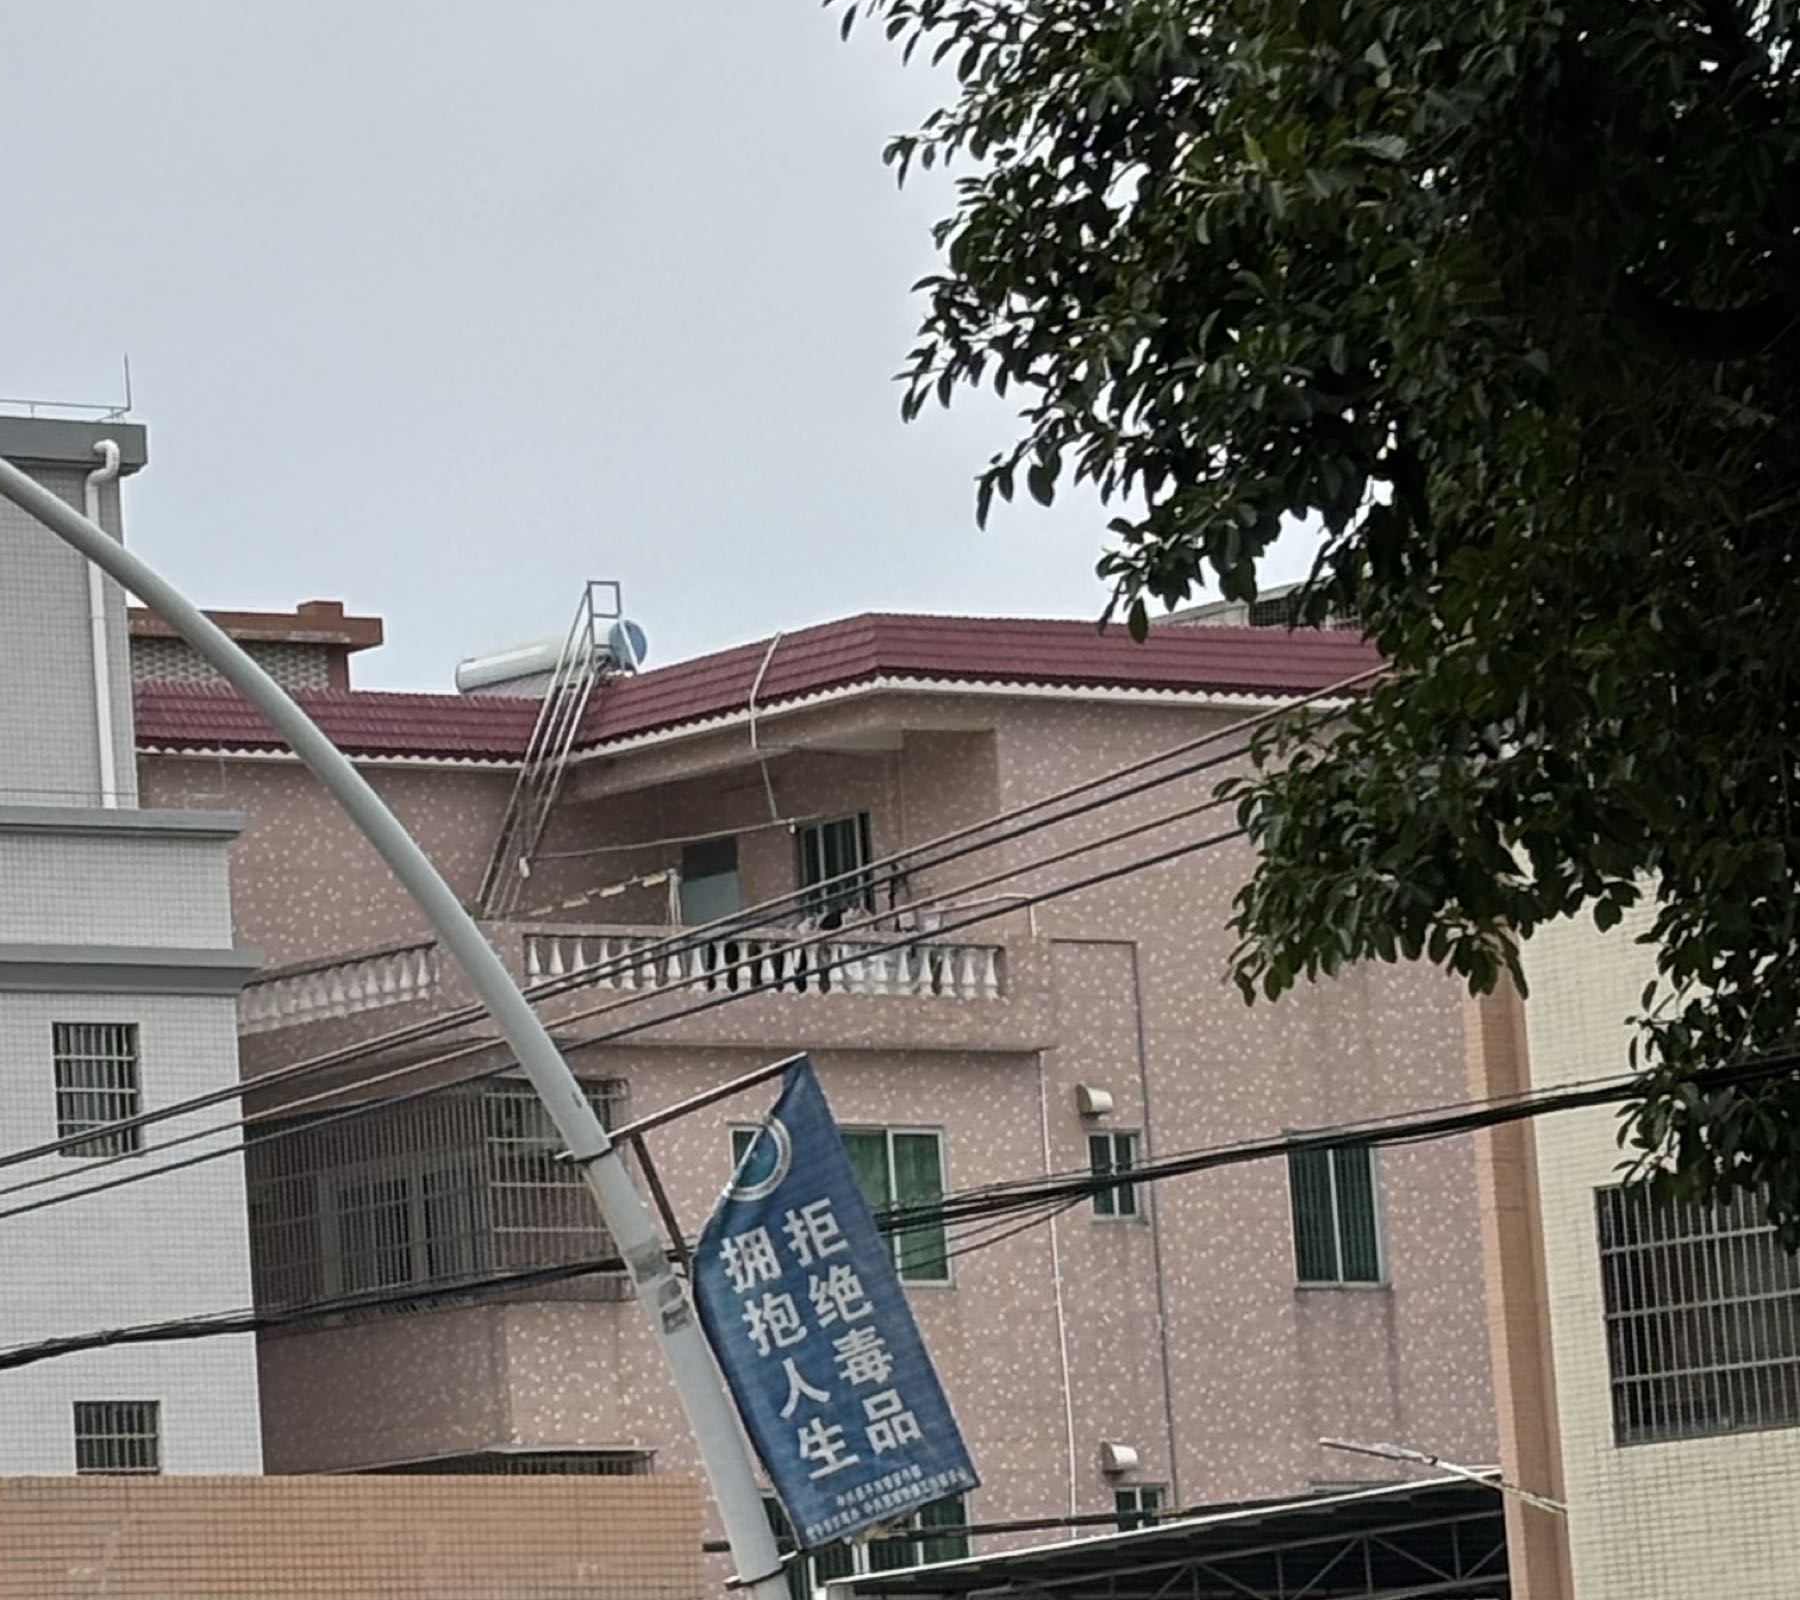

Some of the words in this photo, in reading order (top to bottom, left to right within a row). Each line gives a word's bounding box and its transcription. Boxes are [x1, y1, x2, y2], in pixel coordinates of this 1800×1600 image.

[719, 1225, 860, 1481] 拥抱人生
[783, 1197, 922, 1456] 拒绝毒品
